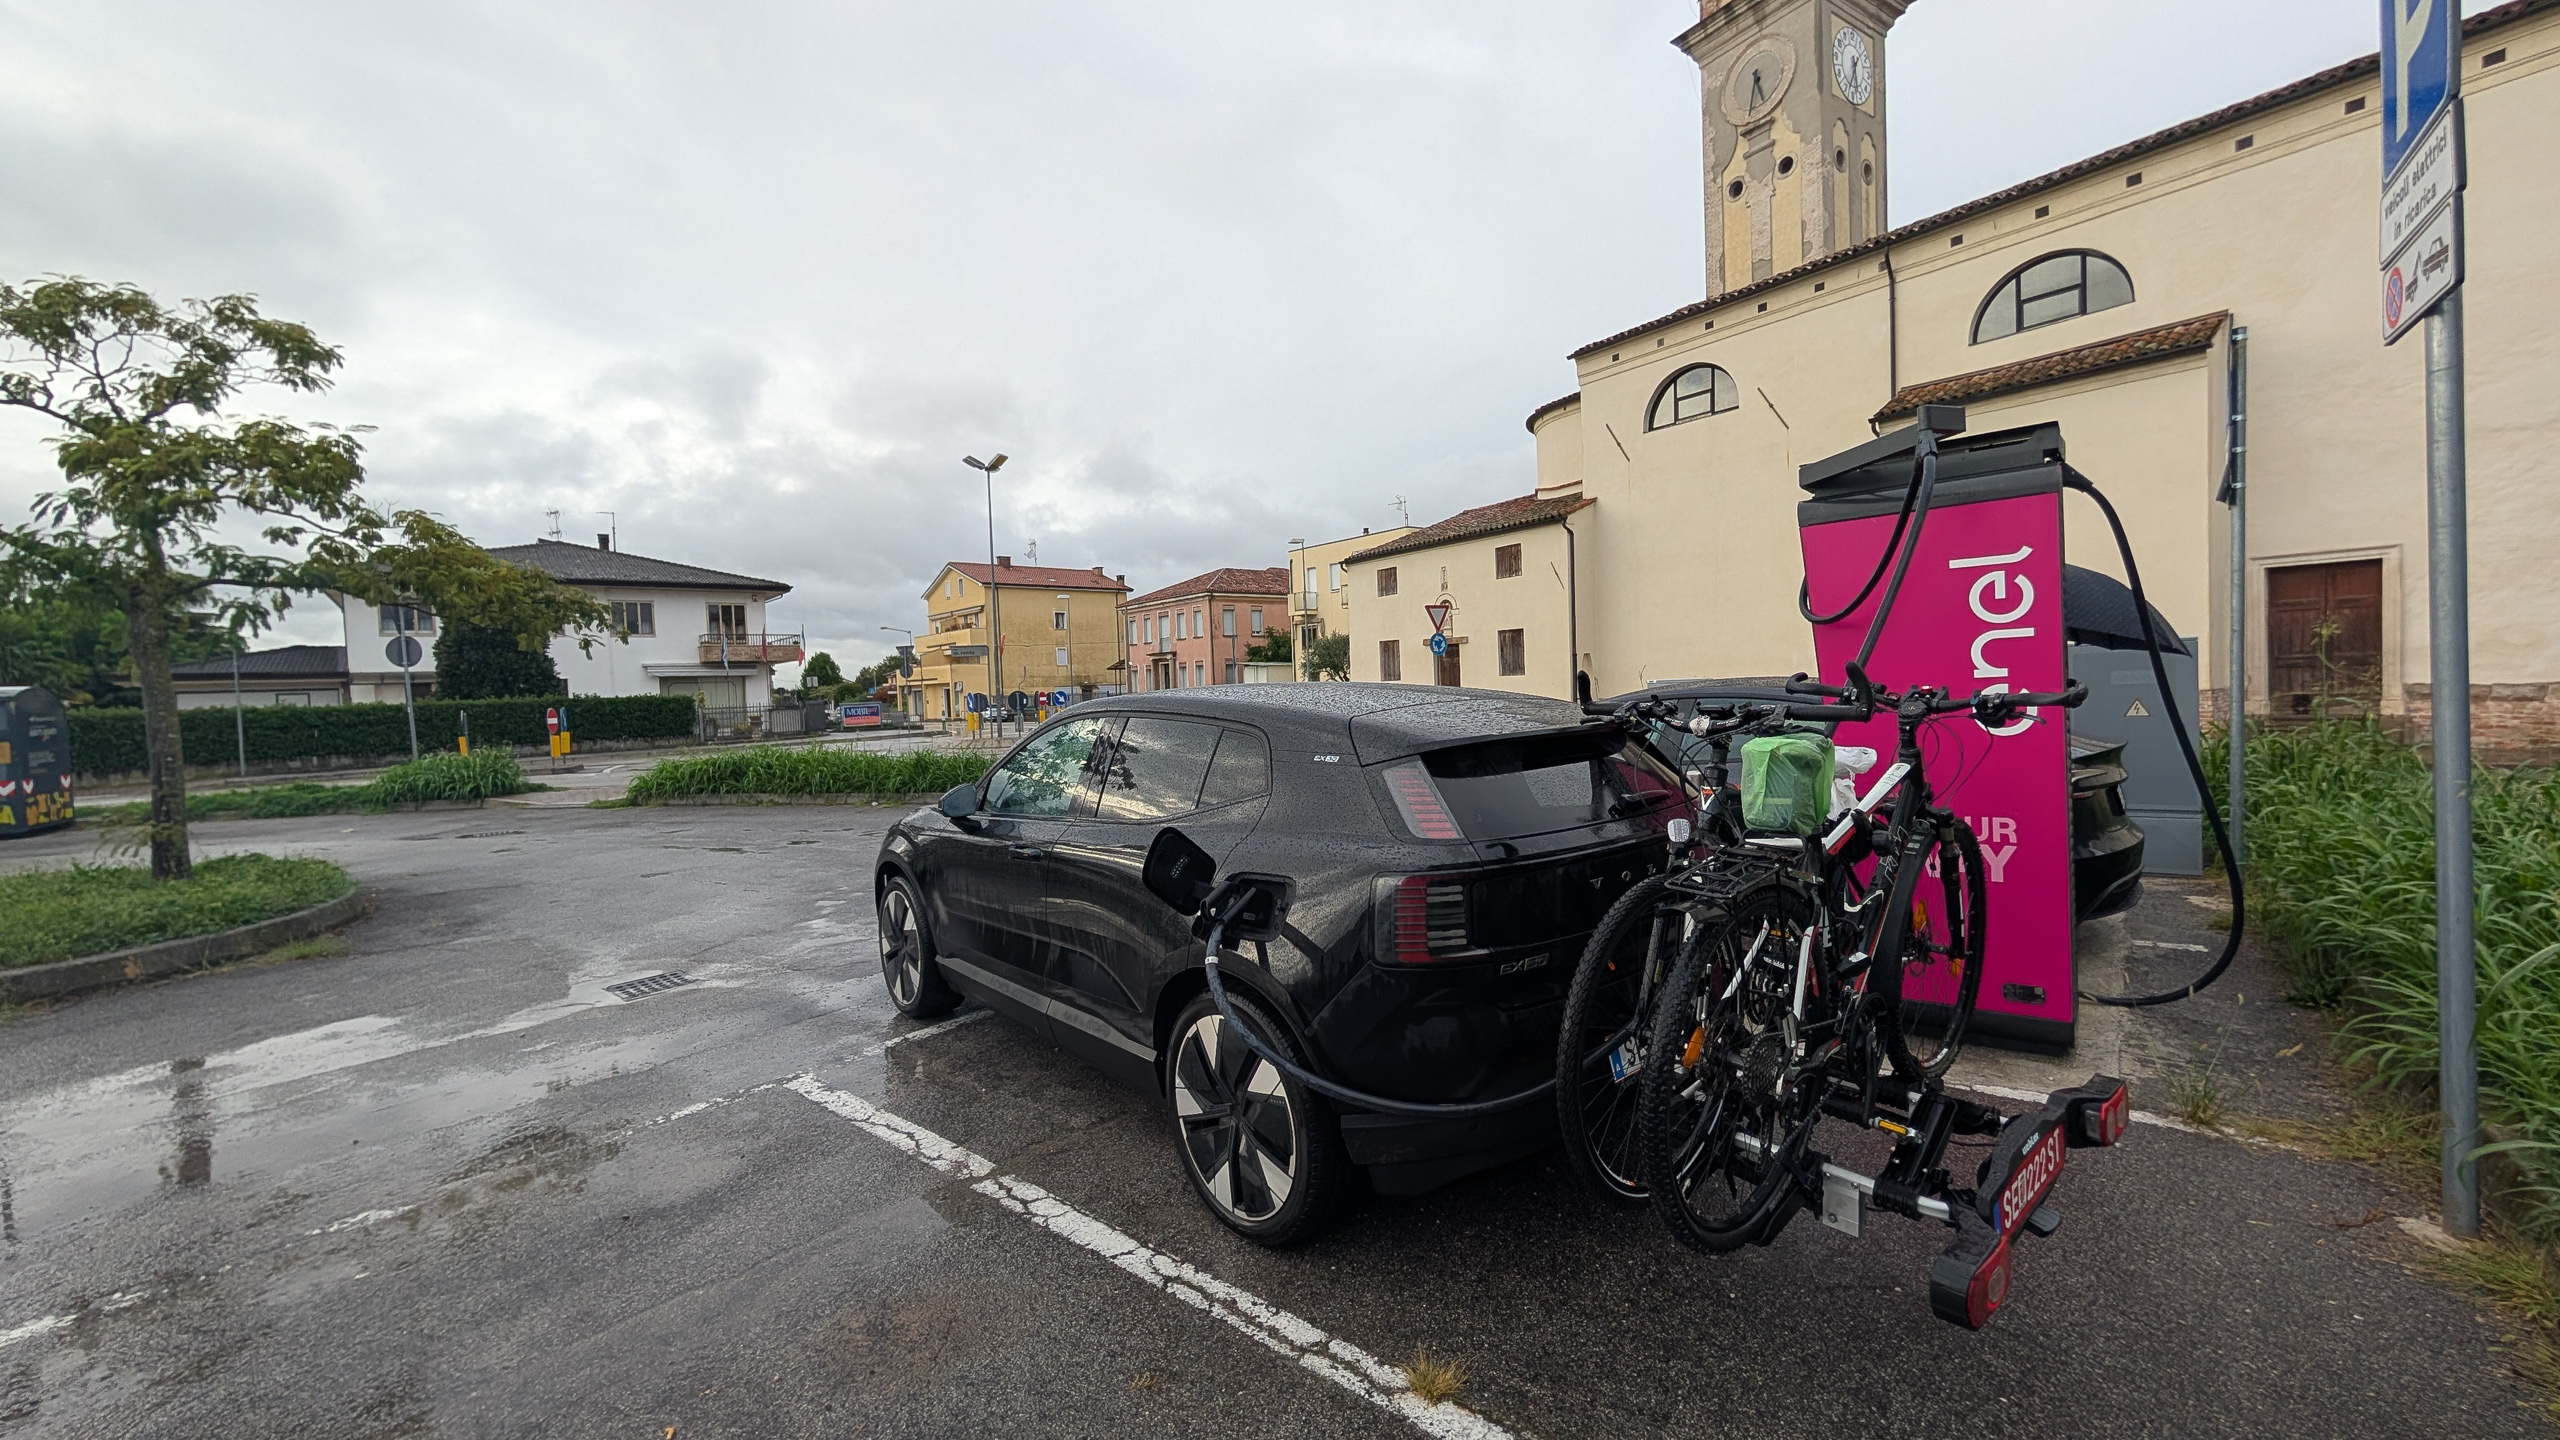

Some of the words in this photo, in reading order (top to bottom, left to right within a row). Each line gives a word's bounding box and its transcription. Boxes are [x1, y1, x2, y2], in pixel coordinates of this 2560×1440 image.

[2384, 175, 2409, 220] veicoli
[2412, 126, 2447, 187] elettrici
[2393, 221, 2402, 241] in
[2404, 183, 2437, 229] ricarica
[1964, 816, 2018, 843] UR
